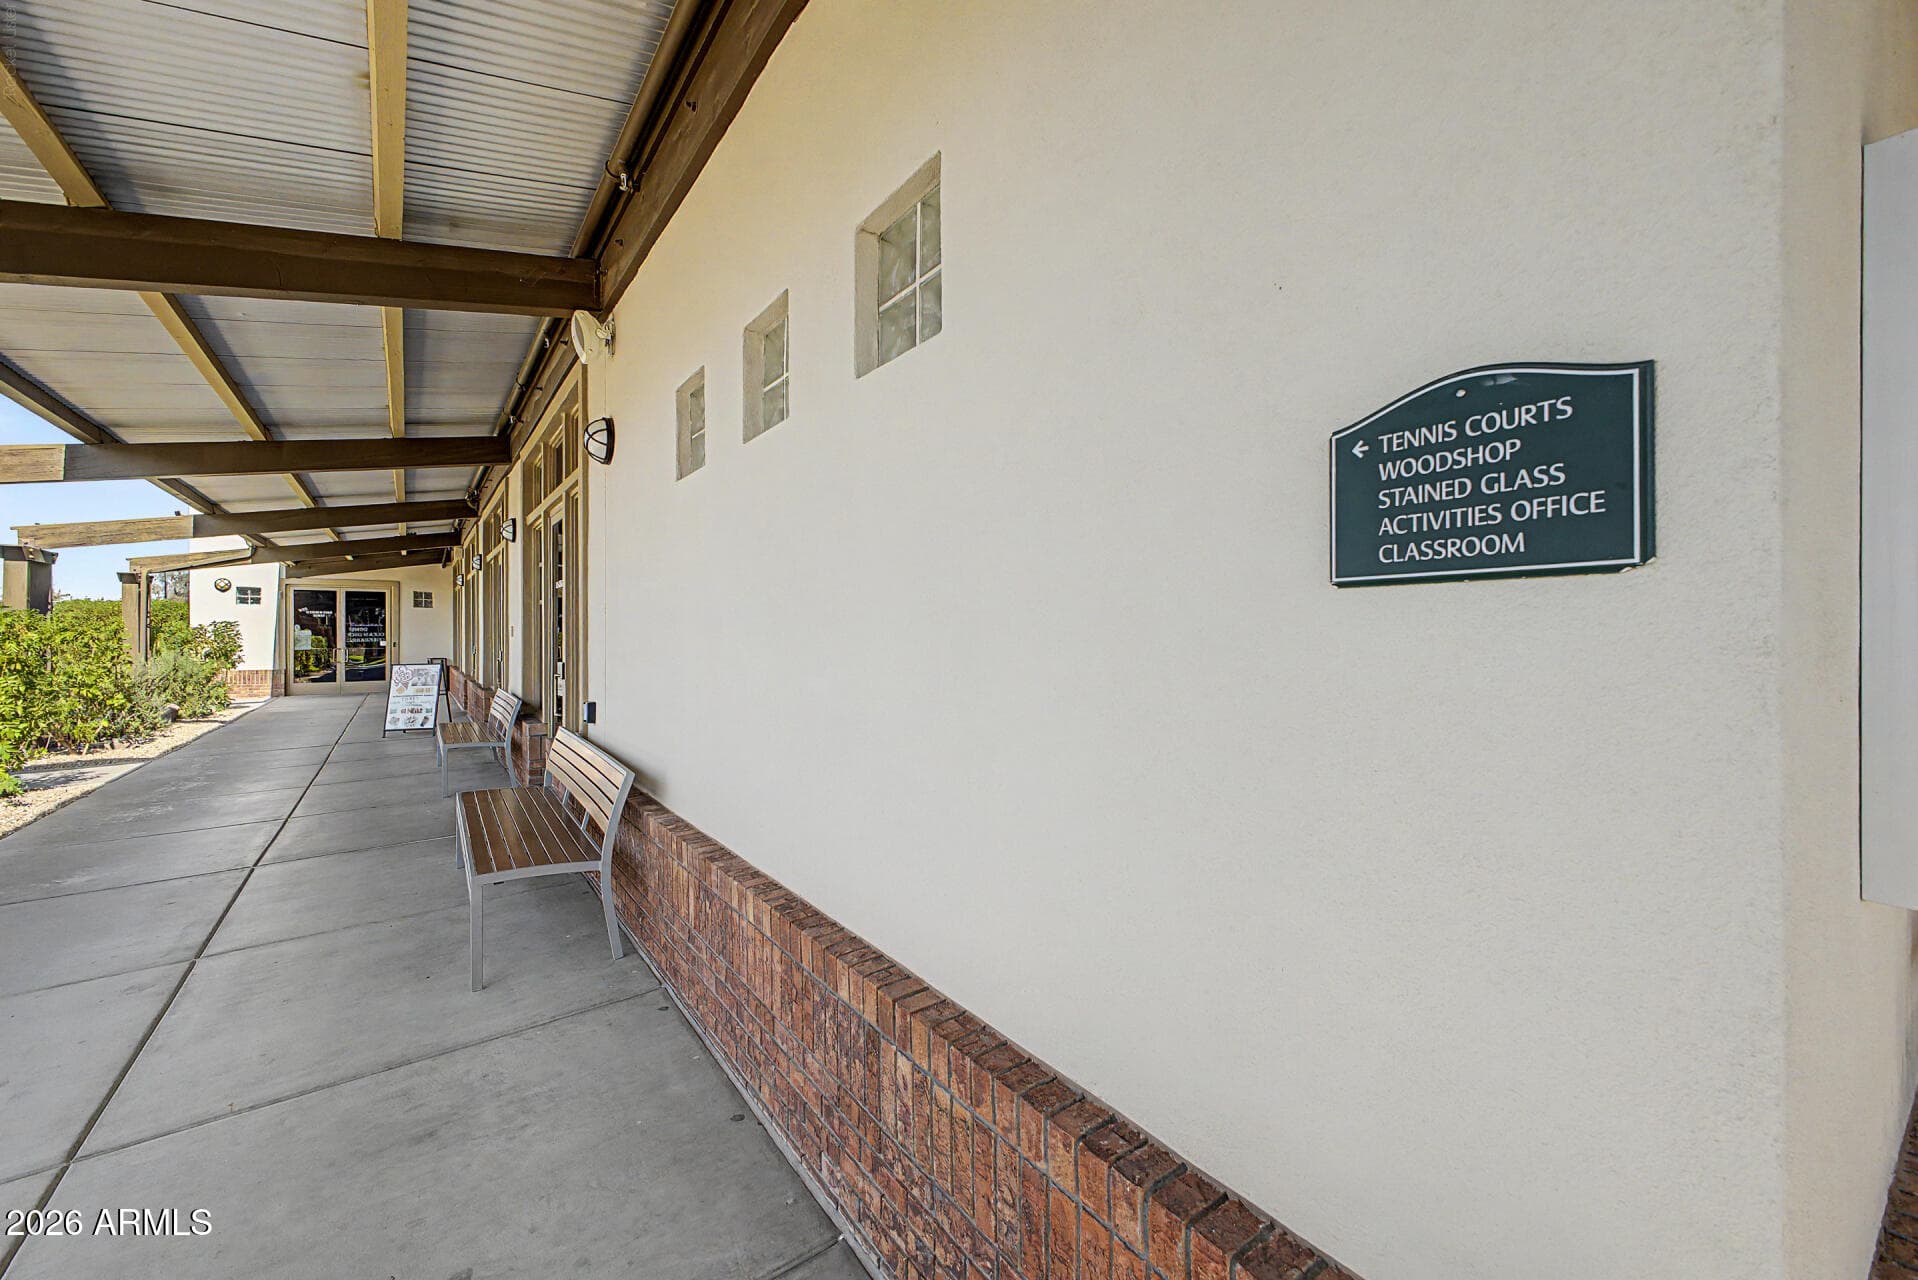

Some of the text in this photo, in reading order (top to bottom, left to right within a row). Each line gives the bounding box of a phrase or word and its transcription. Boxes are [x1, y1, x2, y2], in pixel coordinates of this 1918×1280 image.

[1377, 396, 1574, 454] TENNIS COURTS
[1378, 438, 1521, 481] WOODSHOP
[1378, 462, 1567, 509] STAINED GLASS
[1378, 490, 1607, 537] ACTIVITIES OFFICE
[1378, 531, 1526, 564] CLASSROOM
